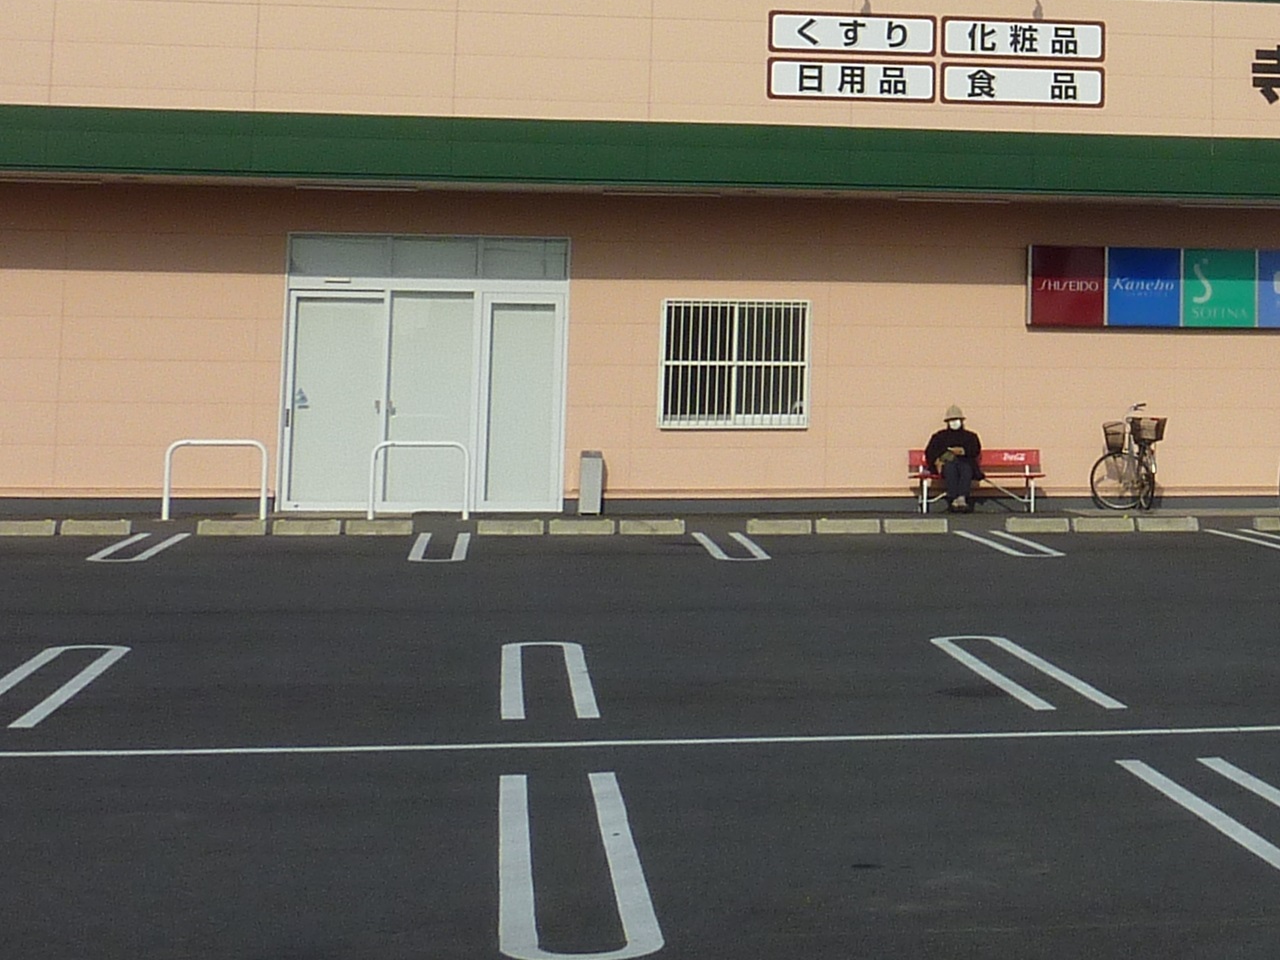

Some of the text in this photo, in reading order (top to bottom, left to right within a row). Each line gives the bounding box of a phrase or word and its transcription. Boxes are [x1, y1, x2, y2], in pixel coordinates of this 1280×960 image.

[796, 19, 912, 47] くすり
[967, 23, 1078, 55] 化粧品
[798, 64, 908, 95] 日用品
[1037, 279, 1099, 292] SHISEIDO
[1112, 277, 1174, 291] Kanebo
